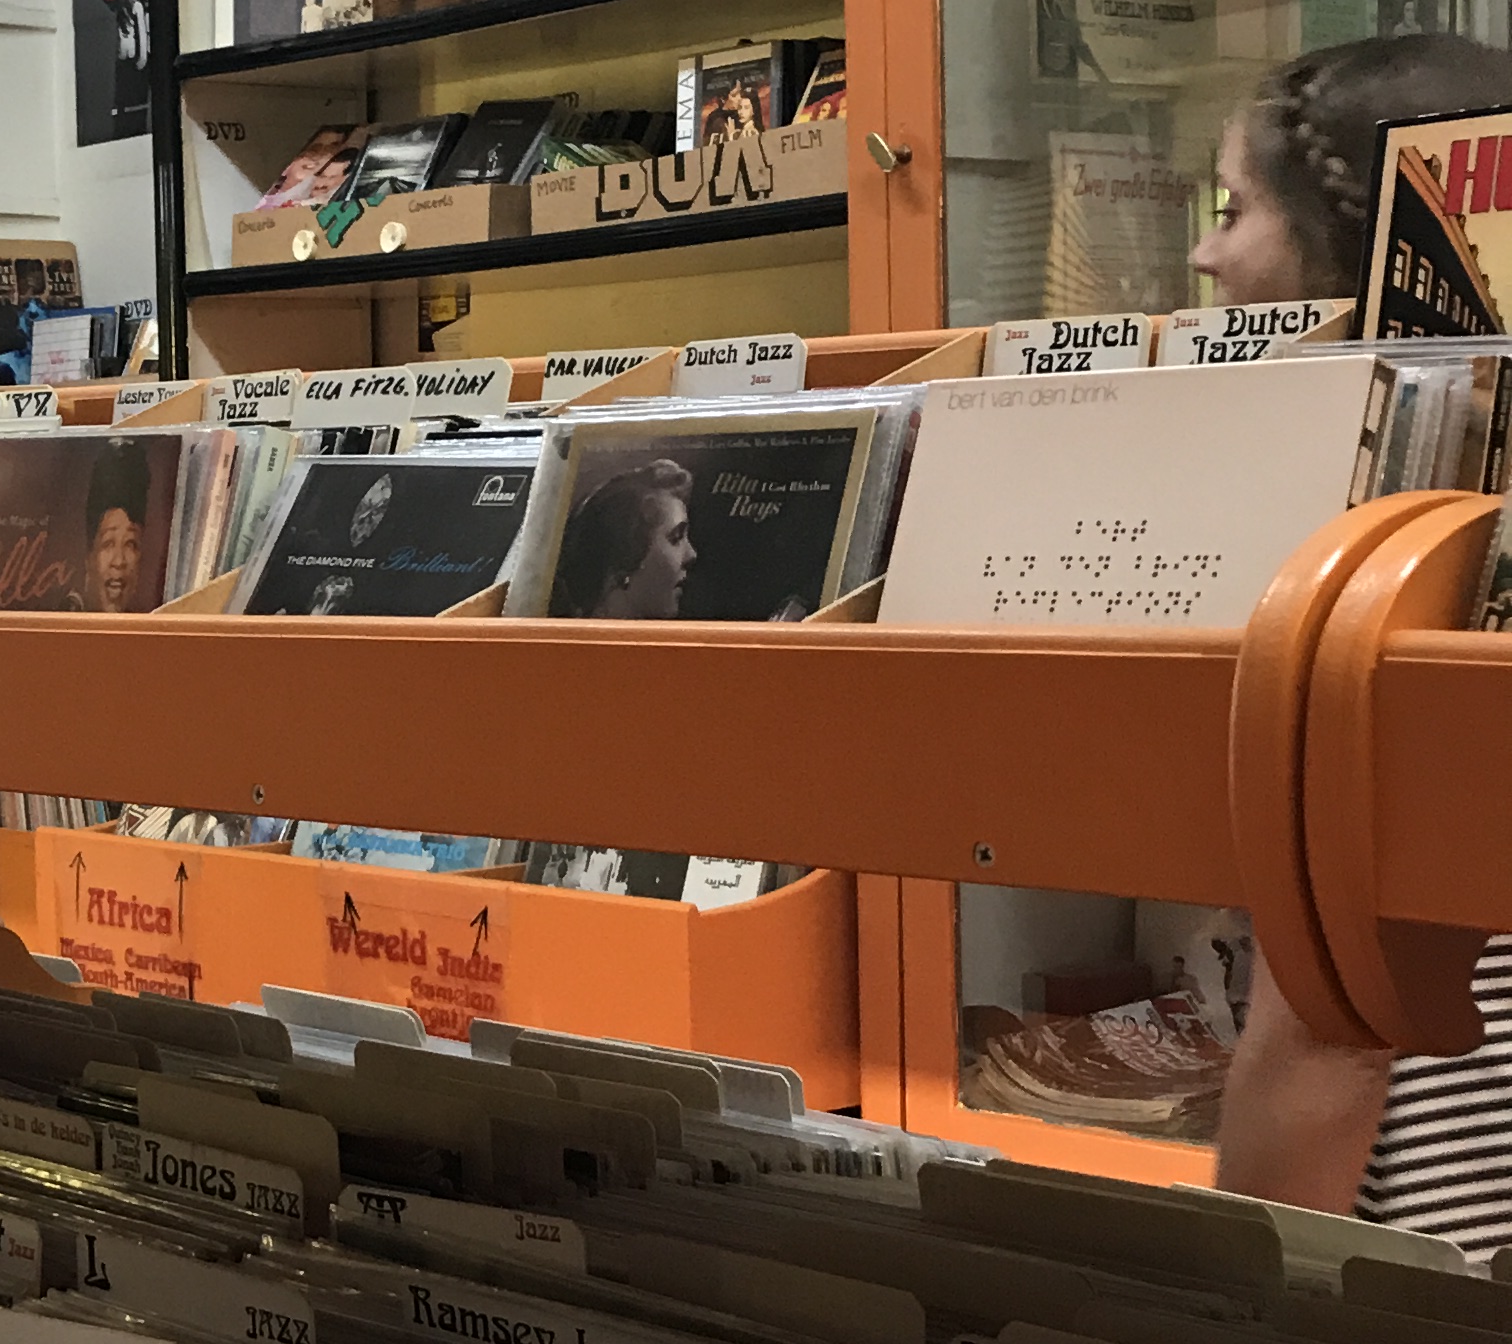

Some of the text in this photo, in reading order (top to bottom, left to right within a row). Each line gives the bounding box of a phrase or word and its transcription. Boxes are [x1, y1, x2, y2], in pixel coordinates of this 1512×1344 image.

[204, 120, 246, 142] DVD
[780, 128, 823, 154] FILM
[536, 175, 577, 198] MOVIE
[124, 299, 153, 319] DVD
[1225, 303, 1322, 337] Dutch
[1049, 321, 1140, 350] Dutch
[684, 343, 794, 367] Dutch Jazz
[1022, 346, 1093, 374] Jazz
[1191, 335, 1270, 365] Jazz
[116, 388, 154, 405] Lester
[233, 375, 291, 400] Vocale
[991, 386, 1025, 408] van
[1029, 385, 1065, 408] den
[217, 399, 259, 421] Jazz
[287, 556, 376, 569] THE DIAMOND FIVE
[87, 886, 174, 937] Africa
[325, 915, 428, 967] Wereld
[144, 1139, 302, 1221] Jones JAZZ
[513, 1212, 562, 1244] Jazz
[83, 1233, 112, 1292] L
